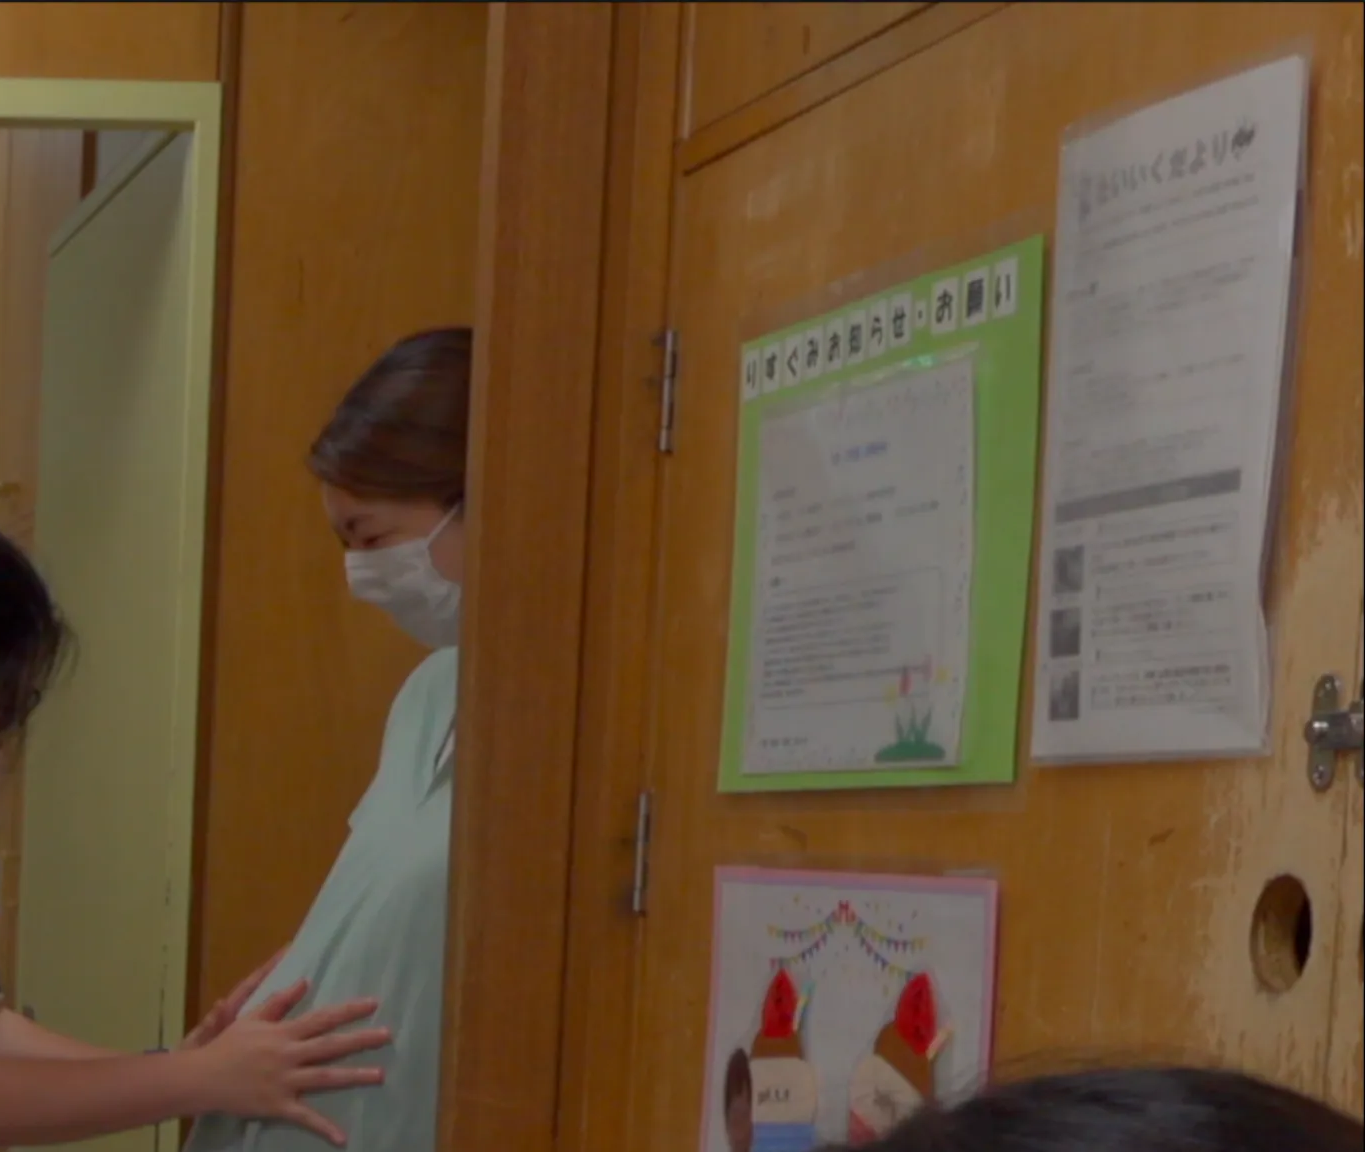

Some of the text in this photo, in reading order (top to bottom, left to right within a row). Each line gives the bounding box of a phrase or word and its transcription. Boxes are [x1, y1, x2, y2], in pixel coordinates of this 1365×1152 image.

[745, 273, 1013, 390] りすぐみお知らせ・お願い
